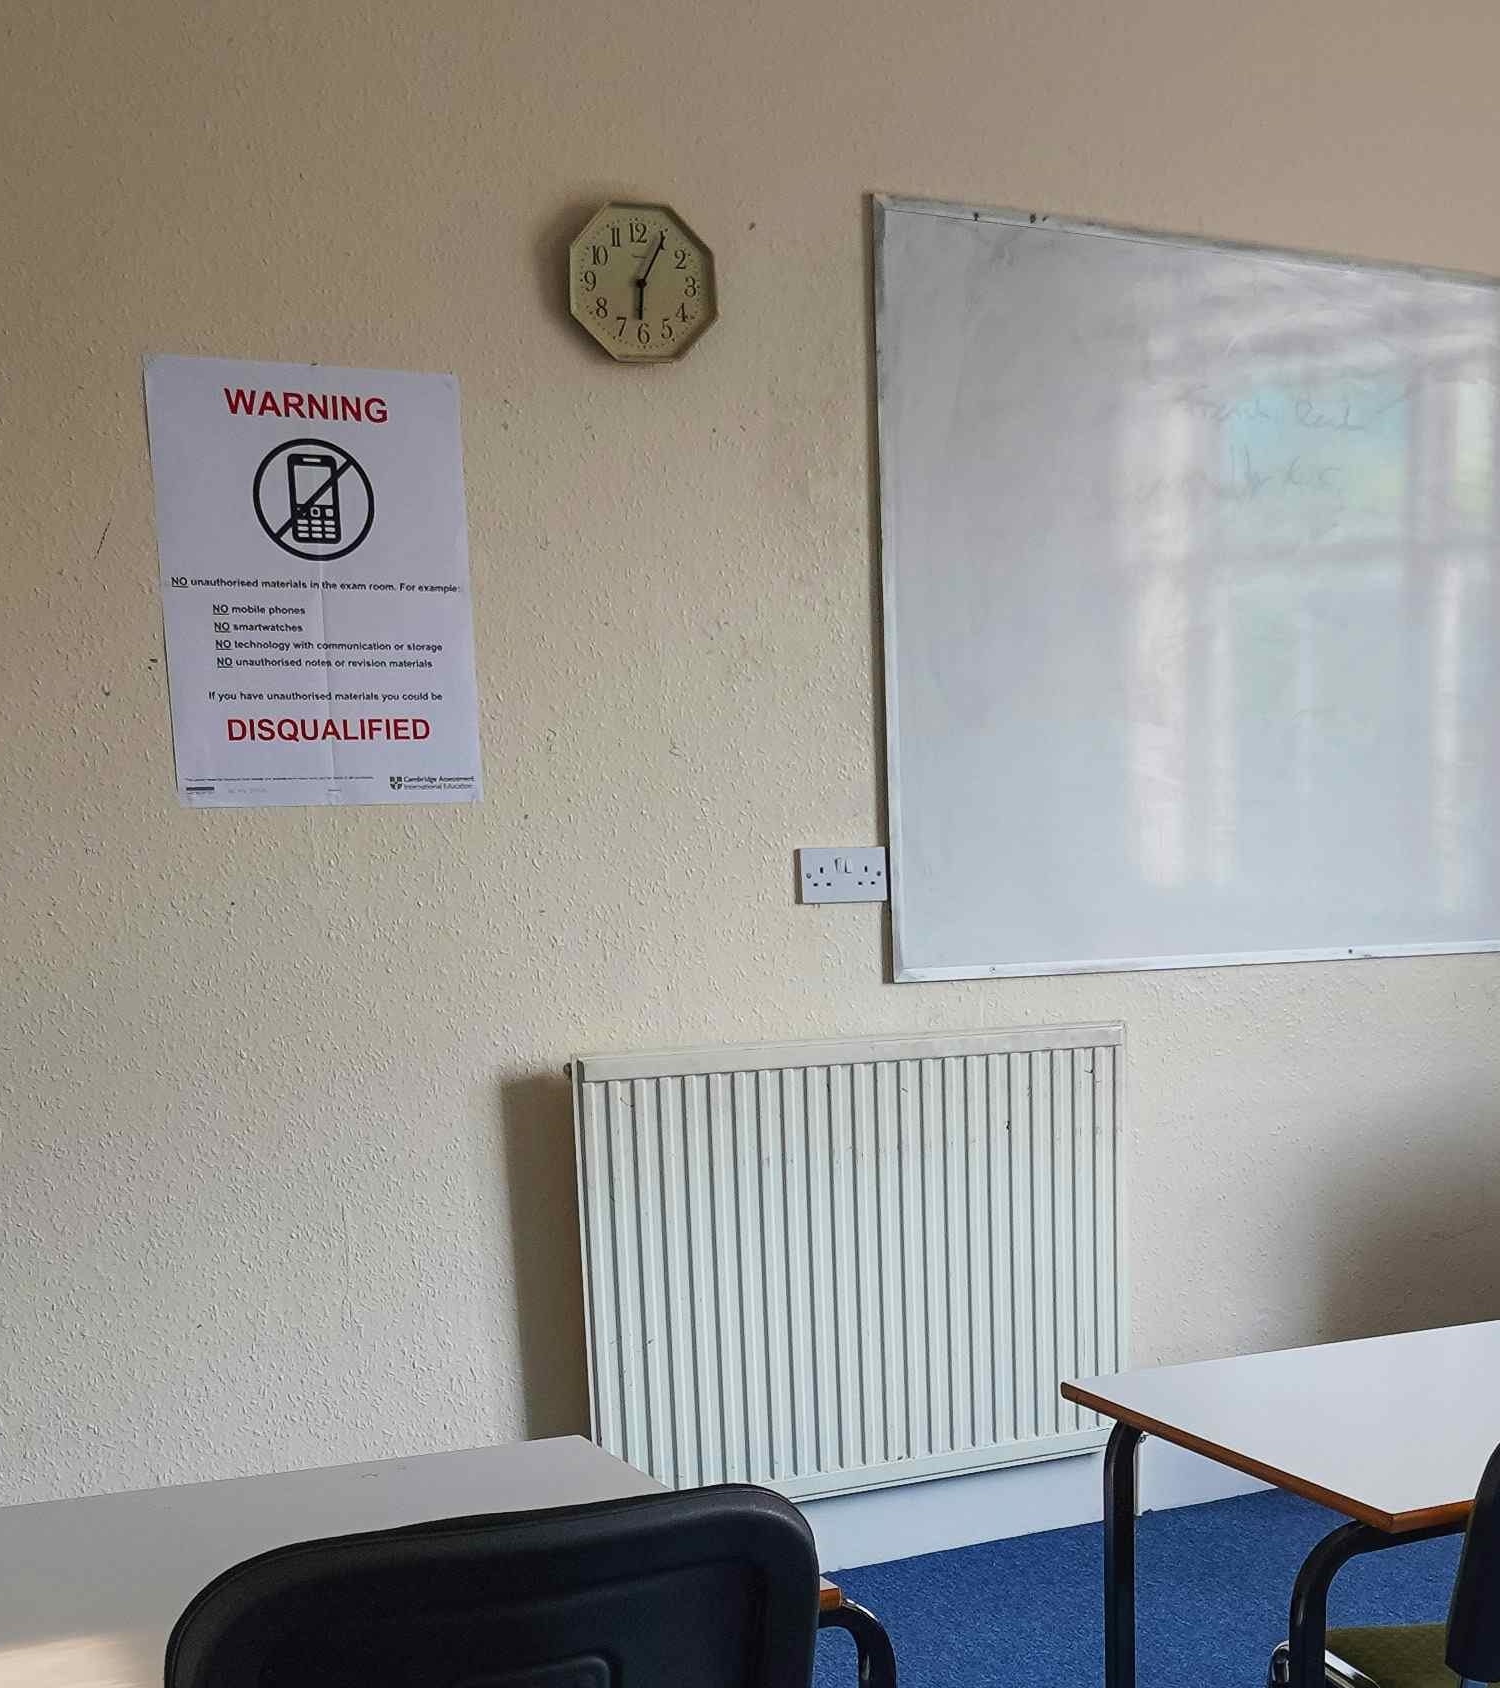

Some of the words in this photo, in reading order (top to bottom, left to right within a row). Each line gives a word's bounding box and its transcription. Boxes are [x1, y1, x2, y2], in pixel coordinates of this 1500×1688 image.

[611, 228, 621, 247] 11
[629, 223, 648, 243] 12
[591, 246, 608, 265] 10
[675, 249, 687, 269] 2
[584, 272, 597, 291] 9
[684, 277, 696, 297] 3
[596, 297, 608, 318] 8
[676, 304, 688, 322] 4
[616, 317, 627, 337] 7
[637, 324, 650, 344] 6
[661, 319, 673, 339] 5
[224, 388, 388, 423] WARNING
[171, 577, 188, 588] NO
[191, 578, 258, 588] unauthorised
[261, 580, 307, 589] materials
[310, 580, 320, 589] in
[322, 581, 337, 590] the
[340, 583, 366, 591] exam
[369, 583, 395, 591] room.
[399, 583, 415, 592] For
[418, 584, 460, 594] example:
[213, 605, 229, 615] NO
[231, 605, 265, 614] mobile
[269, 606, 305, 616] phones
[214, 622, 230, 632] NO
[233, 622, 303, 632] smartwatches
[215, 640, 232, 650] NO
[234, 640, 290, 650] technology
[293, 641, 314, 650] with
[316, 642, 391, 651] communication
[394, 643, 404, 651] or
[407, 642, 443, 652] storage
[217, 658, 233, 668] NO
[236, 658, 302, 667] unauthorised
[305, 659, 331, 667] notes
[348, 659, 386, 667] revision
[389, 659, 432, 668] materials
[208, 692, 216, 700] If
[218, 693, 237, 702] you
[240, 692, 264, 701] have
[267, 692, 331, 701] unauthorised
[335, 692, 379, 701] materials
[382, 693, 399, 702] you
[402, 692, 428, 701] could
[431, 692, 443, 701] be
[227, 718, 430, 741] DISQUALIFIED
